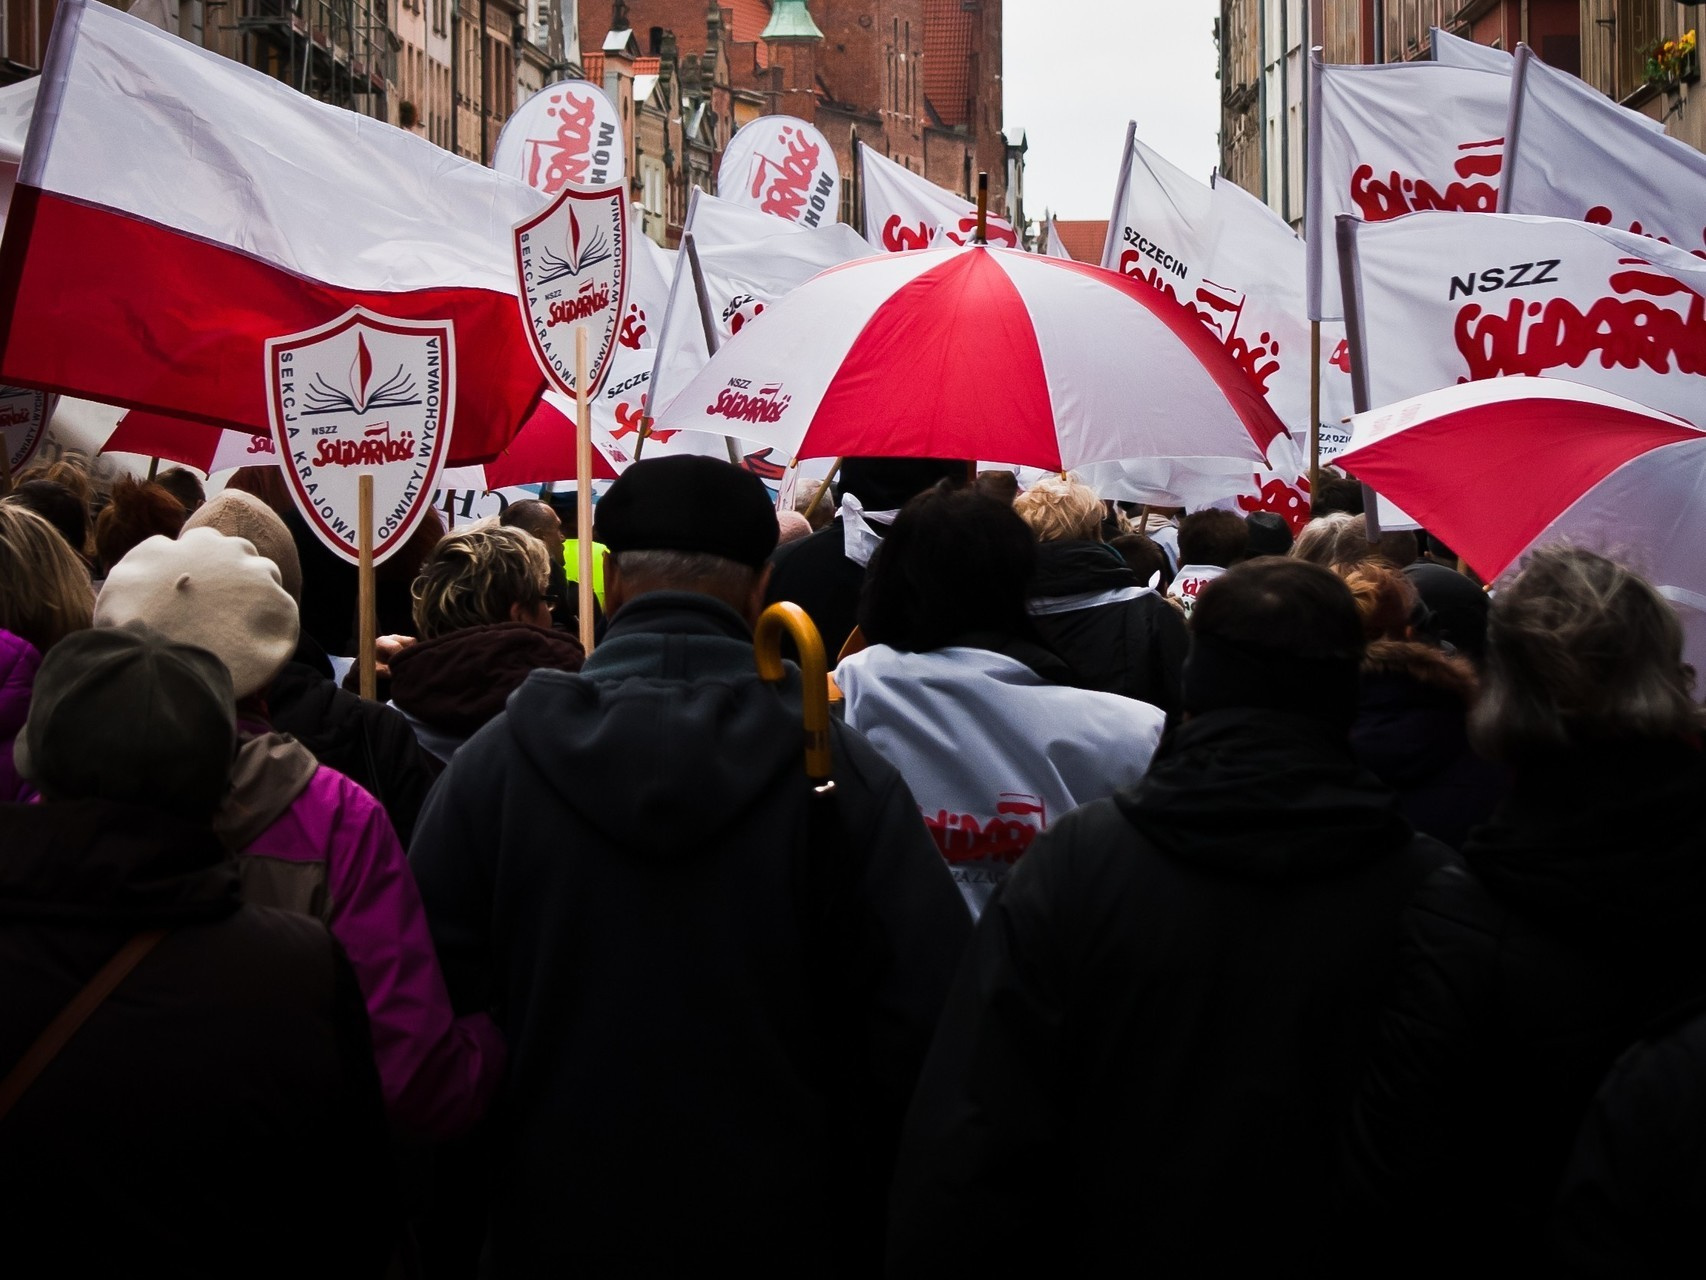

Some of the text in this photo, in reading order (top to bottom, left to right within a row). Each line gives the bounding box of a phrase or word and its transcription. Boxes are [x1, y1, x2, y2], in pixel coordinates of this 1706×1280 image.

[802, 171, 835, 229] HÓW
[1123, 226, 1188, 280] SZCZECIN
[1449, 259, 1561, 301] NSZZ
[521, 233, 577, 389] SEKCJA KRAJOWA
[545, 289, 562, 301] NSZZ
[589, 318, 615, 380] OŚWIATY
[610, 196, 621, 305] WYCHOWANIA
[607, 370, 653, 399] SZCZE
[727, 377, 753, 390] NSZZ
[281, 353, 357, 544] SEKCJA KRAJOWA
[311, 425, 338, 436] NSZZ
[377, 470, 424, 540] OŚWIATY
[418, 337, 440, 457] WYCHOWANIA
